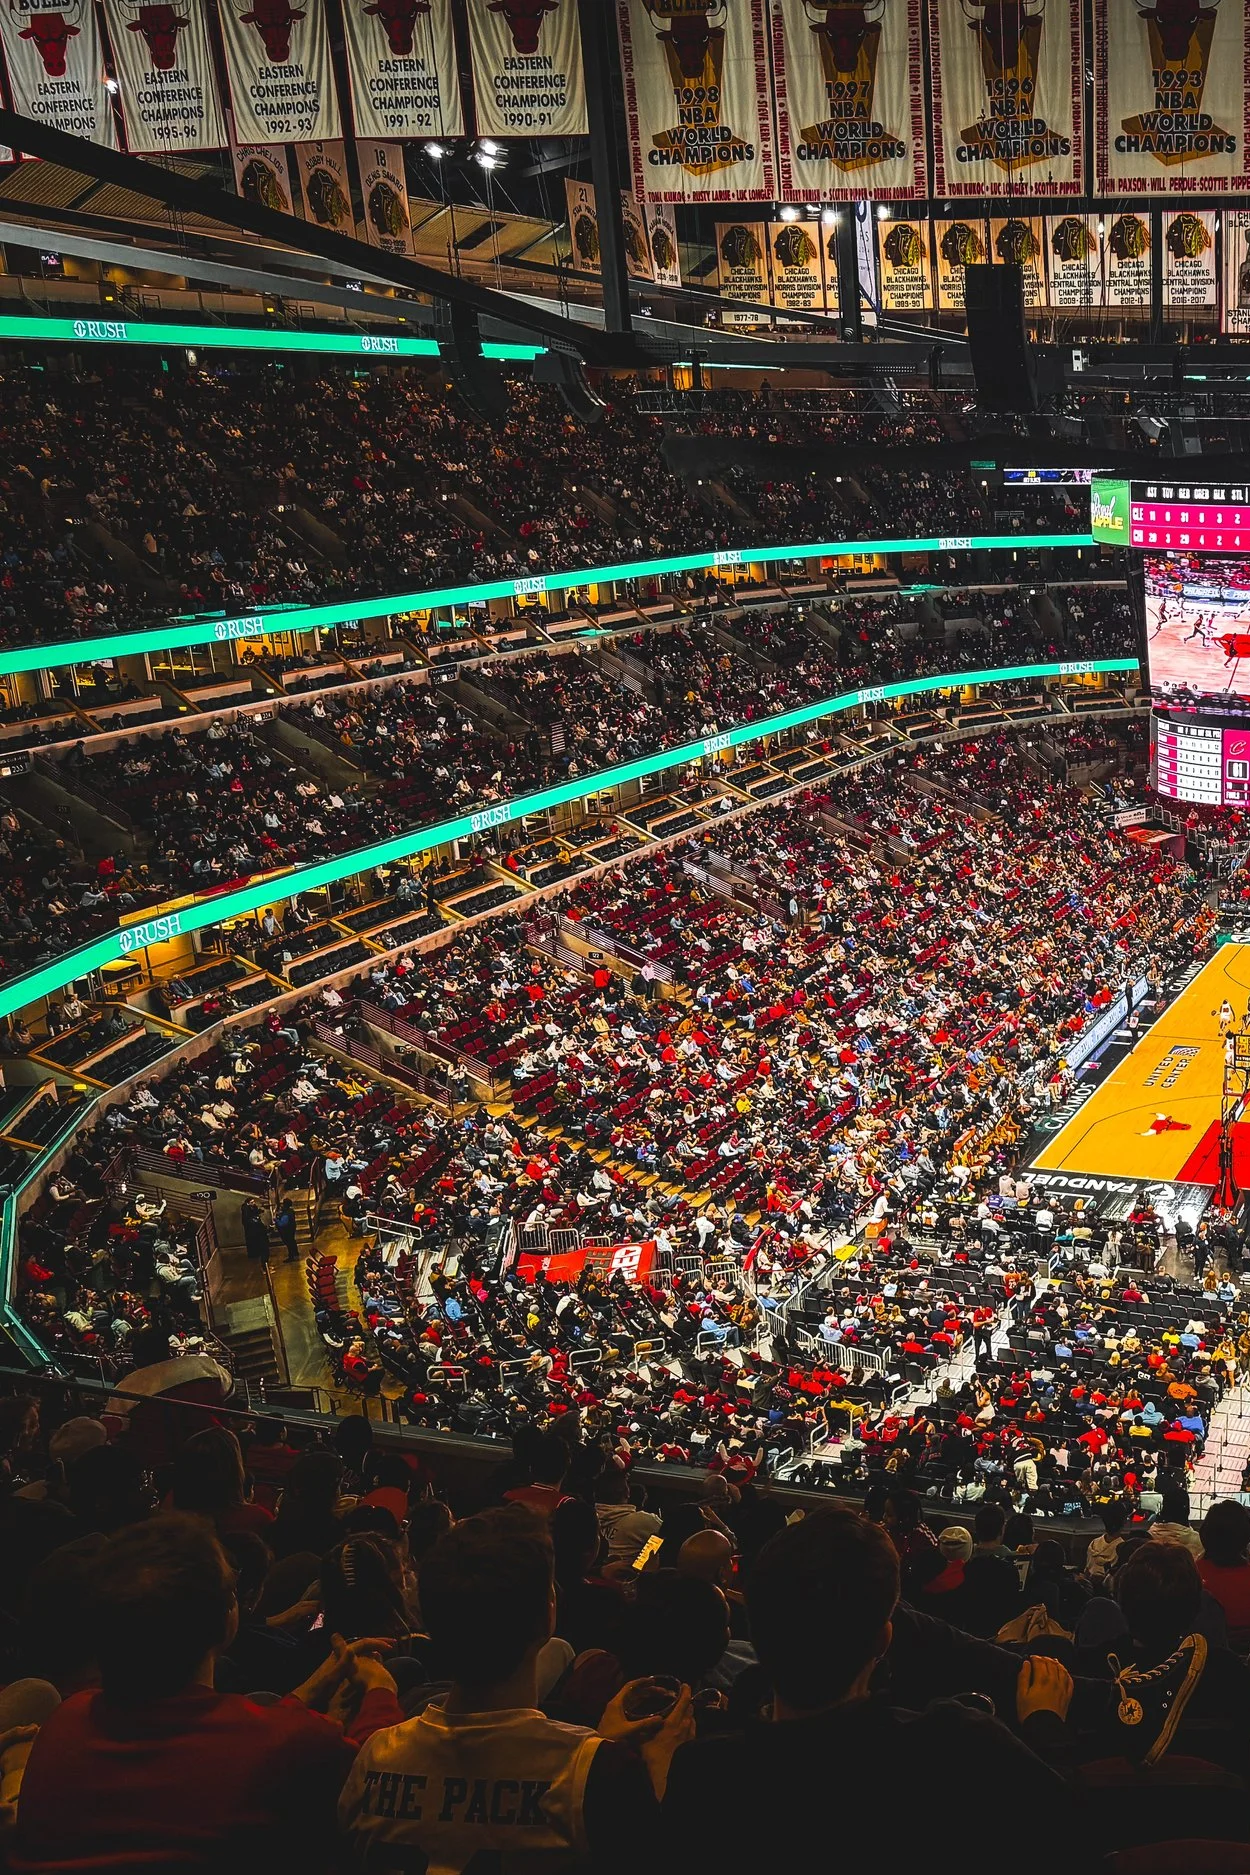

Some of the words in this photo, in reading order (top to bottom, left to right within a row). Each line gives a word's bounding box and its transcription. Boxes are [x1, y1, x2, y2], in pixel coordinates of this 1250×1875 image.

[379, 59, 424, 73] EASTERN
[503, 56, 552, 70] EASTERN
[144, 69, 188, 84] EASTERN
[259, 65, 303, 80] EASTERN
[1152, 68, 1203, 88] 1993
[39, 82, 80, 95] EASTERN
[250, 82, 316, 98] CONFERENCE
[369, 76, 438, 91] CONFERENCE
[494, 74, 566, 90] CONFERENCE
[825, 80, 870, 99] 1997
[986, 77, 1034, 96] 1996
[138, 87, 202, 104] CONFERENCE
[372, 93, 439, 110] CHAMPIONS
[496, 93, 566, 108] CHAMPIONS
[674, 85, 720, 104] 1998
[1155, 90, 1198, 109] NBA
[31, 100, 94, 114] CONFERENCE
[141, 106, 203, 122] CHAMPIONS
[254, 99, 319, 116] CHAMPIONS
[678, 105, 718, 124] NBA
[829, 99, 870, 119] NBA
[990, 98, 1033, 117] NBA
[265, 119, 312, 134] 1992-93
[384, 114, 432, 128] 1991-92
[503, 113, 553, 127] 1990-91
[1139, 112, 1213, 132] WORLD
[152, 125, 197, 140] 1995-96
[667, 126, 733, 145] WORLD
[816, 121, 884, 140] WORLD
[976, 119, 1047, 140] WORLD
[797, 140, 906, 161] CHAMPIONS
[956, 138, 1072, 162] CHAMPIONS
[1115, 134, 1237, 154] CHAMPIONS
[374, 149, 386, 166] 18
[648, 143, 756, 166] CHAMPIONS
[88, 322, 128, 340] RUSH
[370, 336, 399, 352] RUSH
[947, 537, 972, 549] RUSH
[718, 550, 743, 564] RUSH
[521, 576, 546, 592] RUSH
[227, 617, 264, 638] RUSH
[1068, 661, 1095, 672] RUSH
[864, 687, 886, 700] RUSH
[480, 805, 510, 828] RUSH
[133, 914, 181, 947] RUSH
[1169, 961, 1206, 992] CALAMOS
[1142, 1056, 1174, 1087] UNITED
[1160, 1057, 1192, 1089] CENTER
[1044, 1082, 1097, 1130] CALAMOS
[1020, 1171, 1138, 1194] FANDUEL
[361, 1771, 428, 1821] THE
[439, 1777, 553, 1827] PACK
